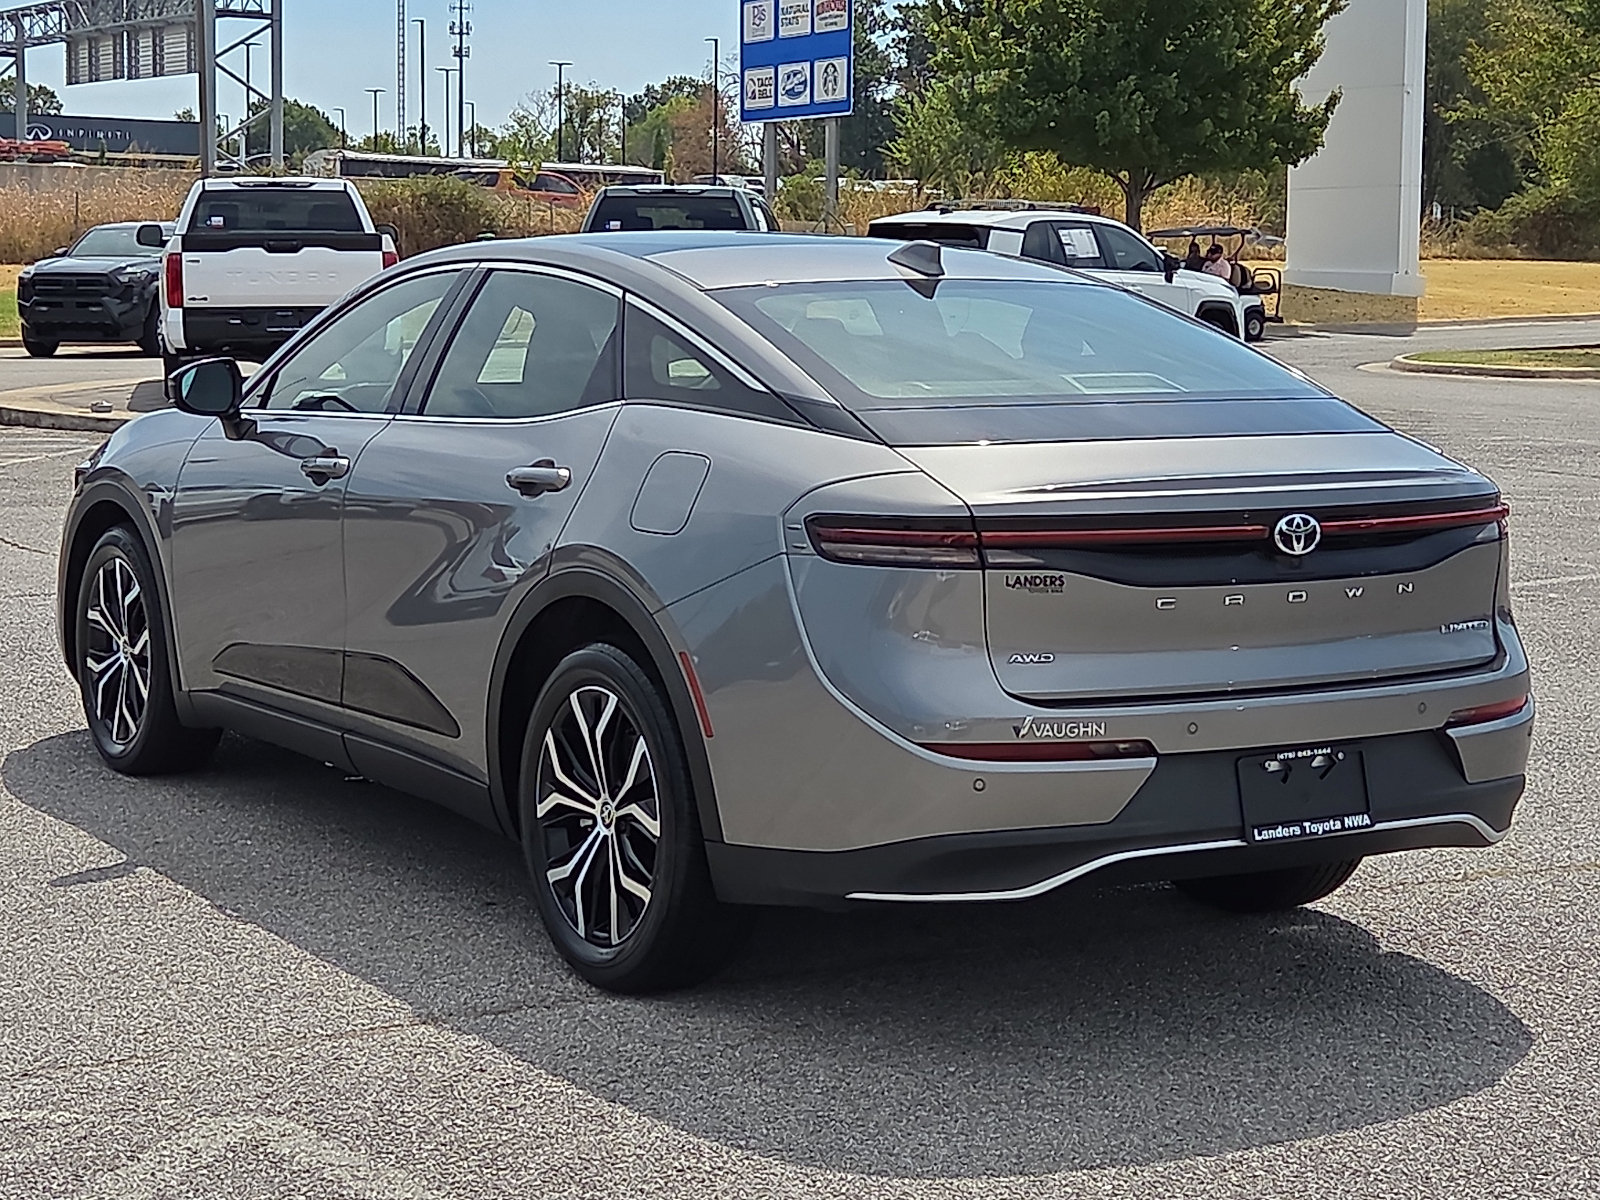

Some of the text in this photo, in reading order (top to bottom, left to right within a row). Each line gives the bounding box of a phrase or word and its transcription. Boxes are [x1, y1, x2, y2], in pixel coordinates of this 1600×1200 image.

[226, 271, 340, 285] TUNDRA
[1005, 574, 1065, 589] LANDERS
[1156, 581, 1413, 611] CROWN
[1440, 619, 1489, 634] LIMITED
[1008, 653, 1055, 664] AWD
[1253, 813, 1371, 841] Landers Toyota NWA
